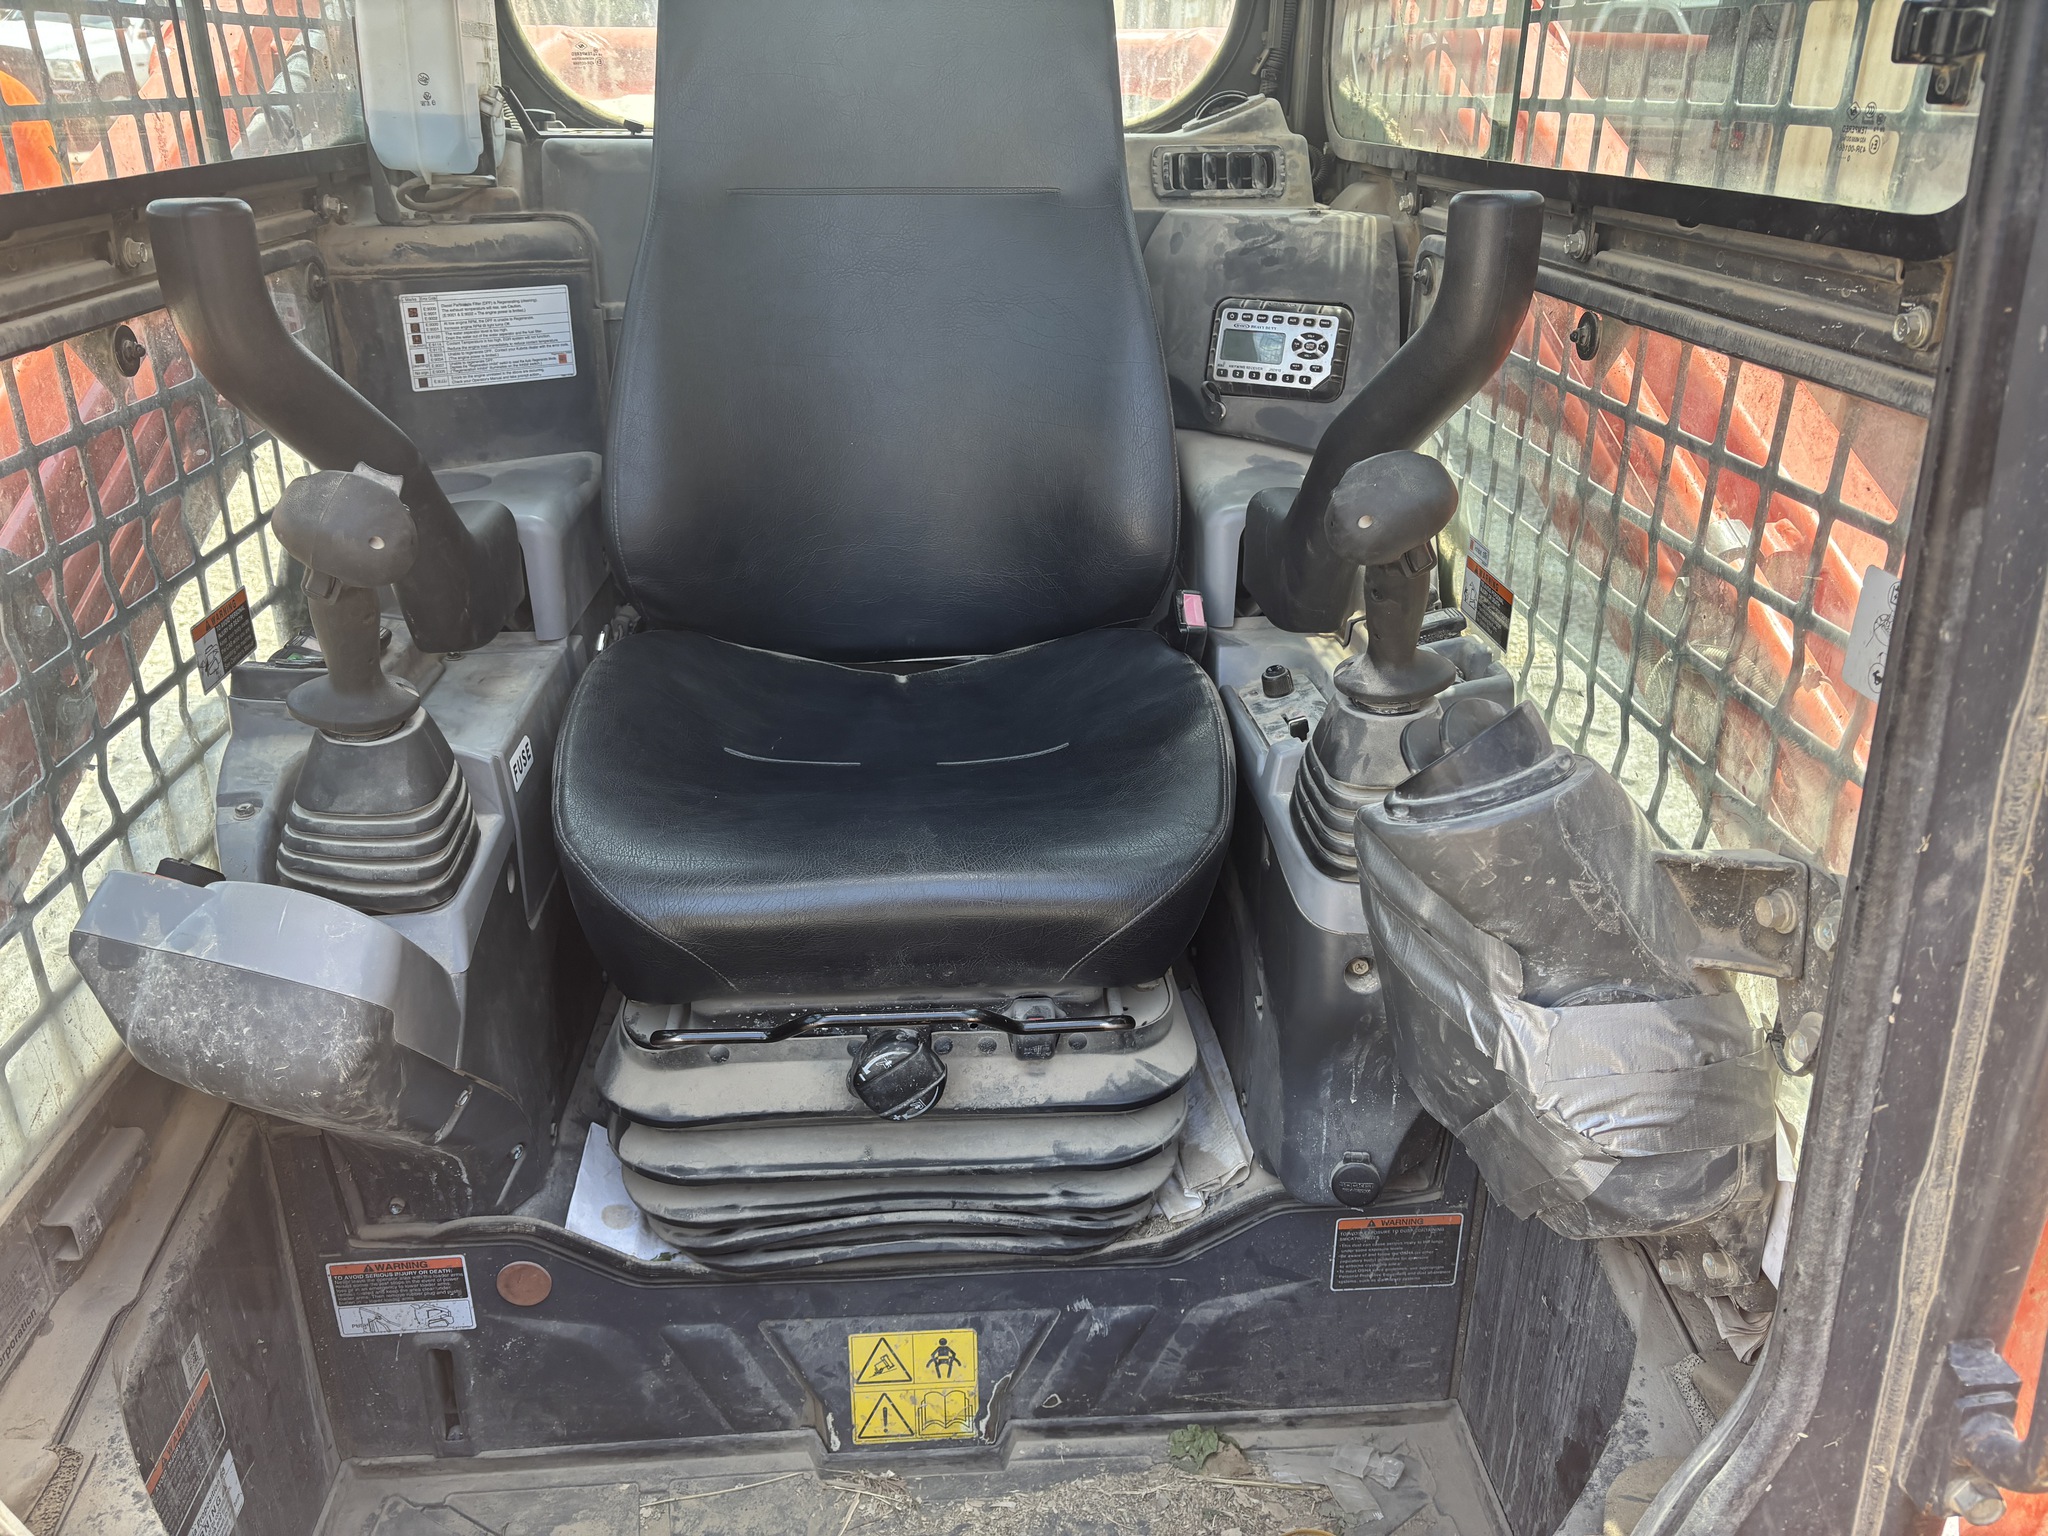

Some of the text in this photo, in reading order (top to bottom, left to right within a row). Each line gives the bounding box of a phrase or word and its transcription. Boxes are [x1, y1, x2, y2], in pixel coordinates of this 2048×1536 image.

[211, 599, 236, 625] WARNING
[513, 742, 531, 782] FUSE
[1381, 1218, 1424, 1226] WARNING
[375, 1261, 428, 1272] WARNING
